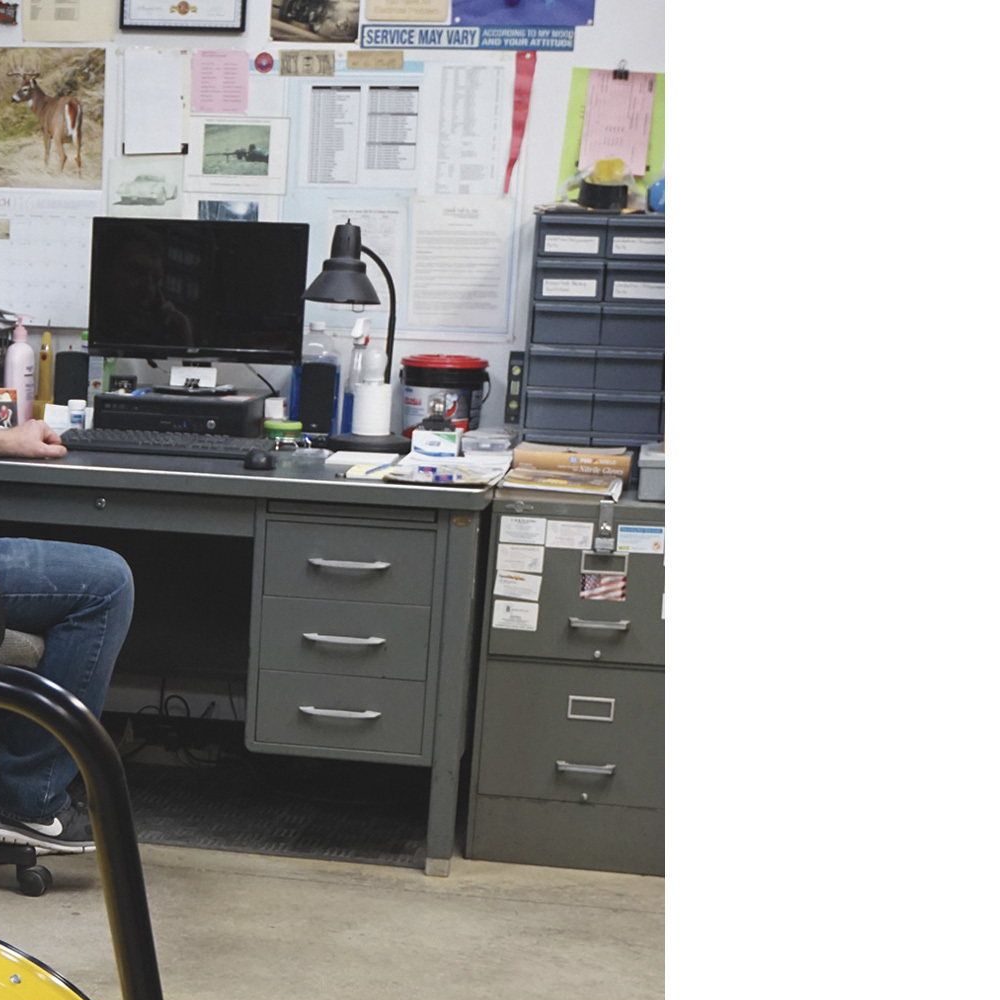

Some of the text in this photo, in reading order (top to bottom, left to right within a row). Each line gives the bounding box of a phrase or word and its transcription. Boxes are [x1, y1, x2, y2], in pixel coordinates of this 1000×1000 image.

[366, 29, 477, 45] SERVICE MAY VARY
[482, 29, 525, 37] ACCORDING
[504, 38, 527, 46] YOUR
[530, 39, 573, 47] ATTITUDE
